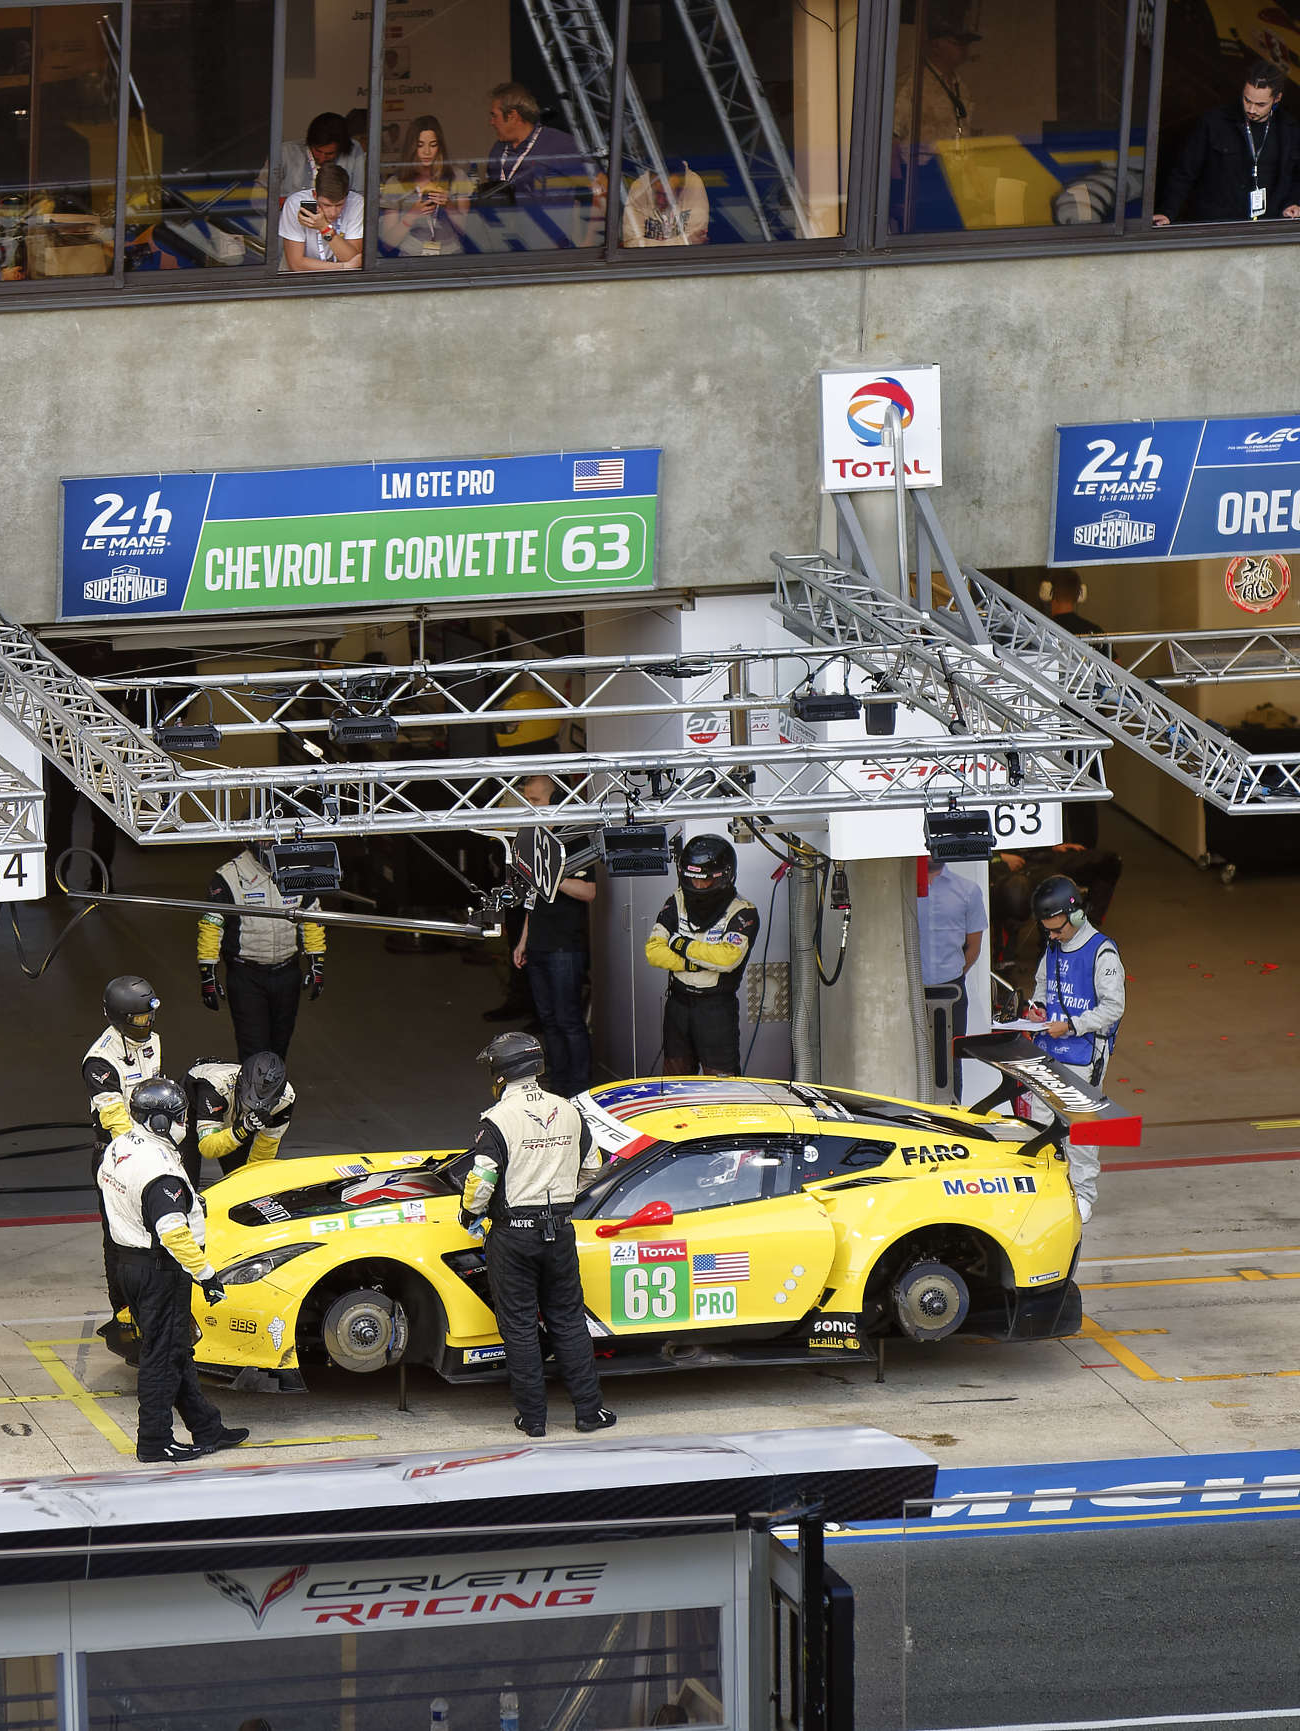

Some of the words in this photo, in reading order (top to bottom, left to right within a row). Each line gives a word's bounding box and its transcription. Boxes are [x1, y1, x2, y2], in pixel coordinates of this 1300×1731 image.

[1077, 437, 1163, 482] 24h
[381, 472, 410, 499] LM
[417, 470, 452, 497] GTE
[456, 469, 495, 495] PRO
[1073, 483, 1097, 496] LE
[1100, 481, 1157, 494] MANS
[85, 491, 172, 536] 24h
[82, 538, 107, 550] LE
[109, 536, 166, 549] MANS
[1074, 521, 1156, 549] SUPERFINALE
[204, 539, 377, 592] CHEVROLET
[384, 530, 538, 580] CORVETTE
[561, 524, 632, 570] 63
[85, 576, 166, 603] SUPERFINALE
[995, 802, 1042, 837] 63
[534, 826, 551, 897] 63
[1063, 996, 1091, 1010] TRACK
[526, 1092, 545, 1102] DIX
[901, 1144, 970, 1165] FARO
[944, 1177, 1009, 1195] Mobil
[1016, 1177, 1034, 1192] 1
[640, 1247, 685, 1258] TOTAL
[624, 1266, 677, 1320] 63
[696, 1291, 734, 1316] PRO
[229, 1318, 257, 1334] BBS
[481, 1351, 506, 1359] MICH
[306, 1563, 608, 1599] CORVETTE
[301, 1587, 597, 1626] RACING
